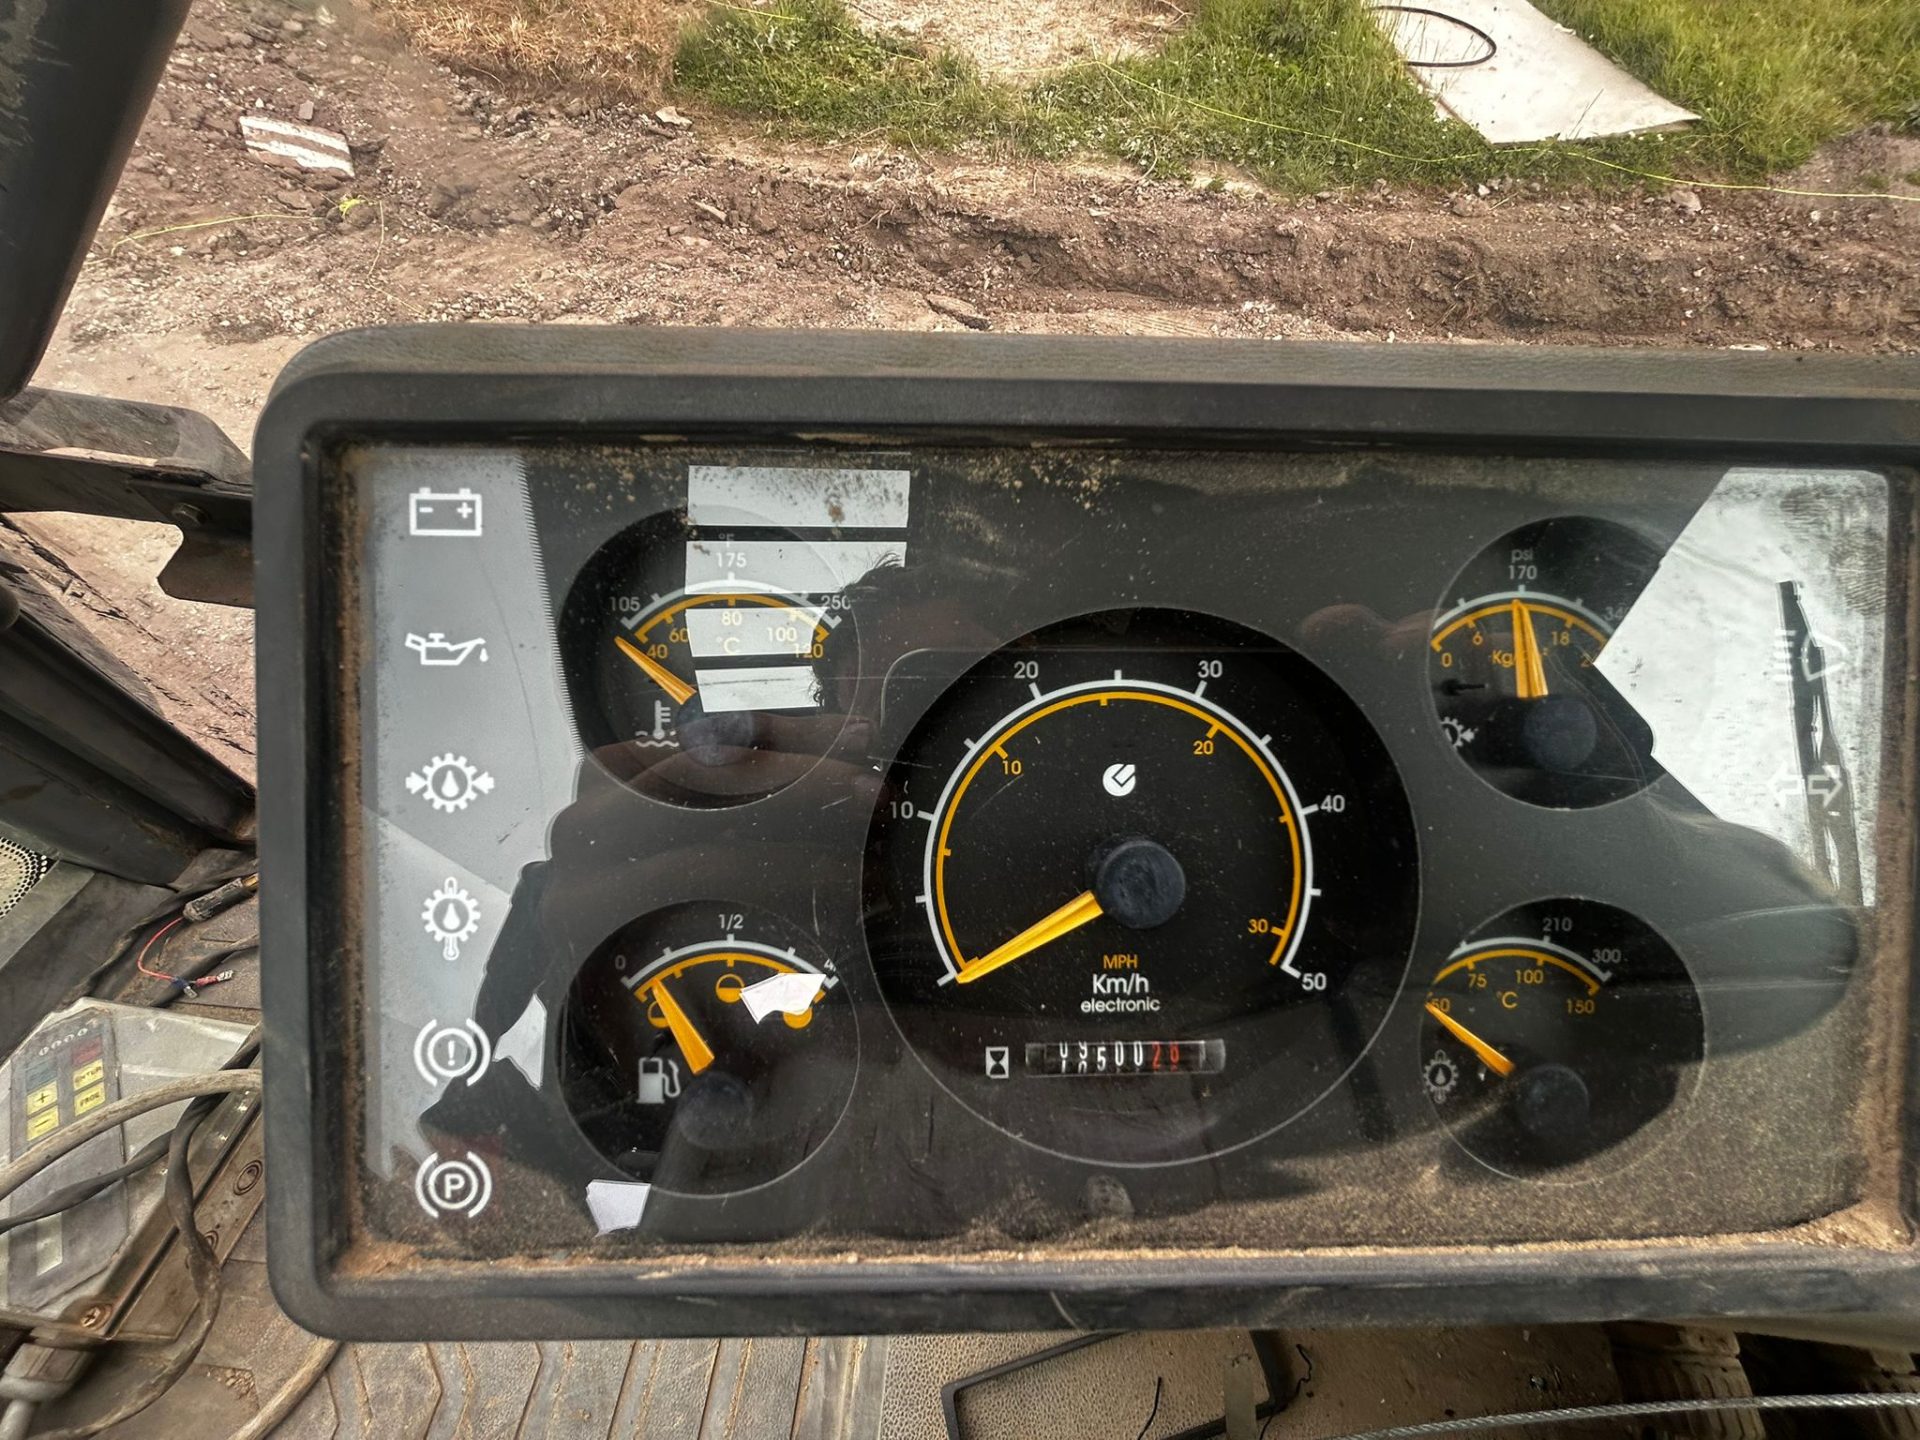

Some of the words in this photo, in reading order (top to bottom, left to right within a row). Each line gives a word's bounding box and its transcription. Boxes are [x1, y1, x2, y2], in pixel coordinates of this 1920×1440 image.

[716, 552, 747, 568] 175
[1511, 549, 1534, 563] psi
[1508, 565, 1538, 580] 170
[610, 597, 641, 612] 105
[821, 595, 851, 610] 250
[721, 611, 742, 626] 80
[1602, 606, 1630, 621] 34
[669, 628, 690, 643] 60
[767, 627, 797, 642] 100
[1472, 632, 1484, 646] 6
[1551, 632, 1570, 646] 18
[646, 644, 668, 659] 40
[794, 643, 824, 659] 120
[1441, 652, 1453, 667] 0
[1013, 661, 1040, 680] 20
[1198, 661, 1223, 679] 30
[1193, 740, 1214, 755] 20
[1002, 760, 1022, 776] 10
[891, 801, 914, 819] 10
[1320, 795, 1346, 813] 40
[719, 914, 745, 930] 1/2
[1247, 919, 1269, 934] 30
[1543, 917, 1573, 932] 210
[614, 955, 627, 971] 0
[1103, 954, 1138, 970] MPH
[1591, 949, 1622, 965] 300
[1092, 973, 1150, 995] Km/h
[1302, 973, 1327, 990] 50
[1468, 973, 1488, 988] 75
[1515, 969, 1544, 985] 100
[1080, 997, 1161, 1013] electronic
[1566, 1000, 1595, 1015] 150
[443, 1172, 466, 1200] P
